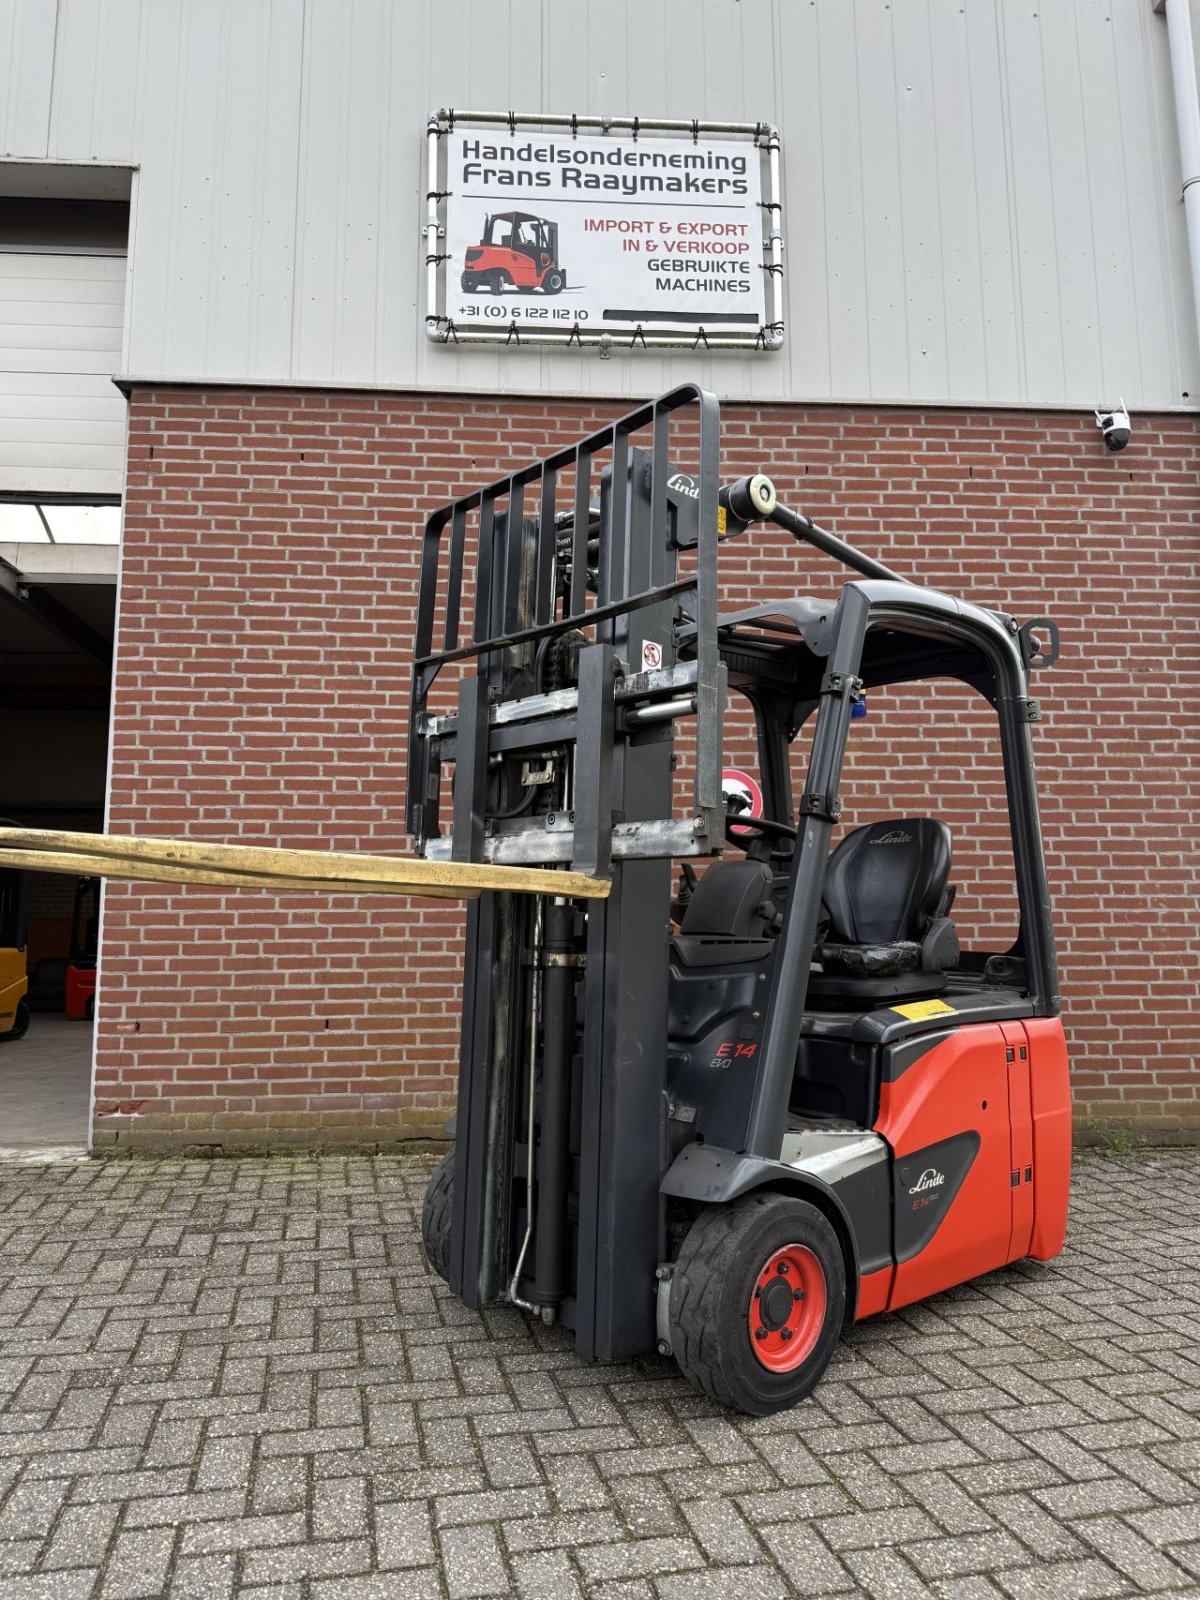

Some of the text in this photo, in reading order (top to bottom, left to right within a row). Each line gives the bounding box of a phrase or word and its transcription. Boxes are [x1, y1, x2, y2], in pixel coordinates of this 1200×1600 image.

[462, 139, 746, 175] Handelsonderneming
[463, 162, 748, 196] Frans Raaymakers
[584, 218, 748, 237] IMPORT & EXPORT
[623, 239, 750, 255] IN & VERKOOP
[647, 258, 750, 274] GEBRUIKTE
[655, 277, 750, 293] MACHINES
[458, 305, 589, 321] +31 (0) 6 122 112 10
[667, 473, 700, 499] Lind
[869, 830, 913, 844] Linde
[709, 1058, 732, 1069] EVO
[908, 1168, 945, 1194] Linde
